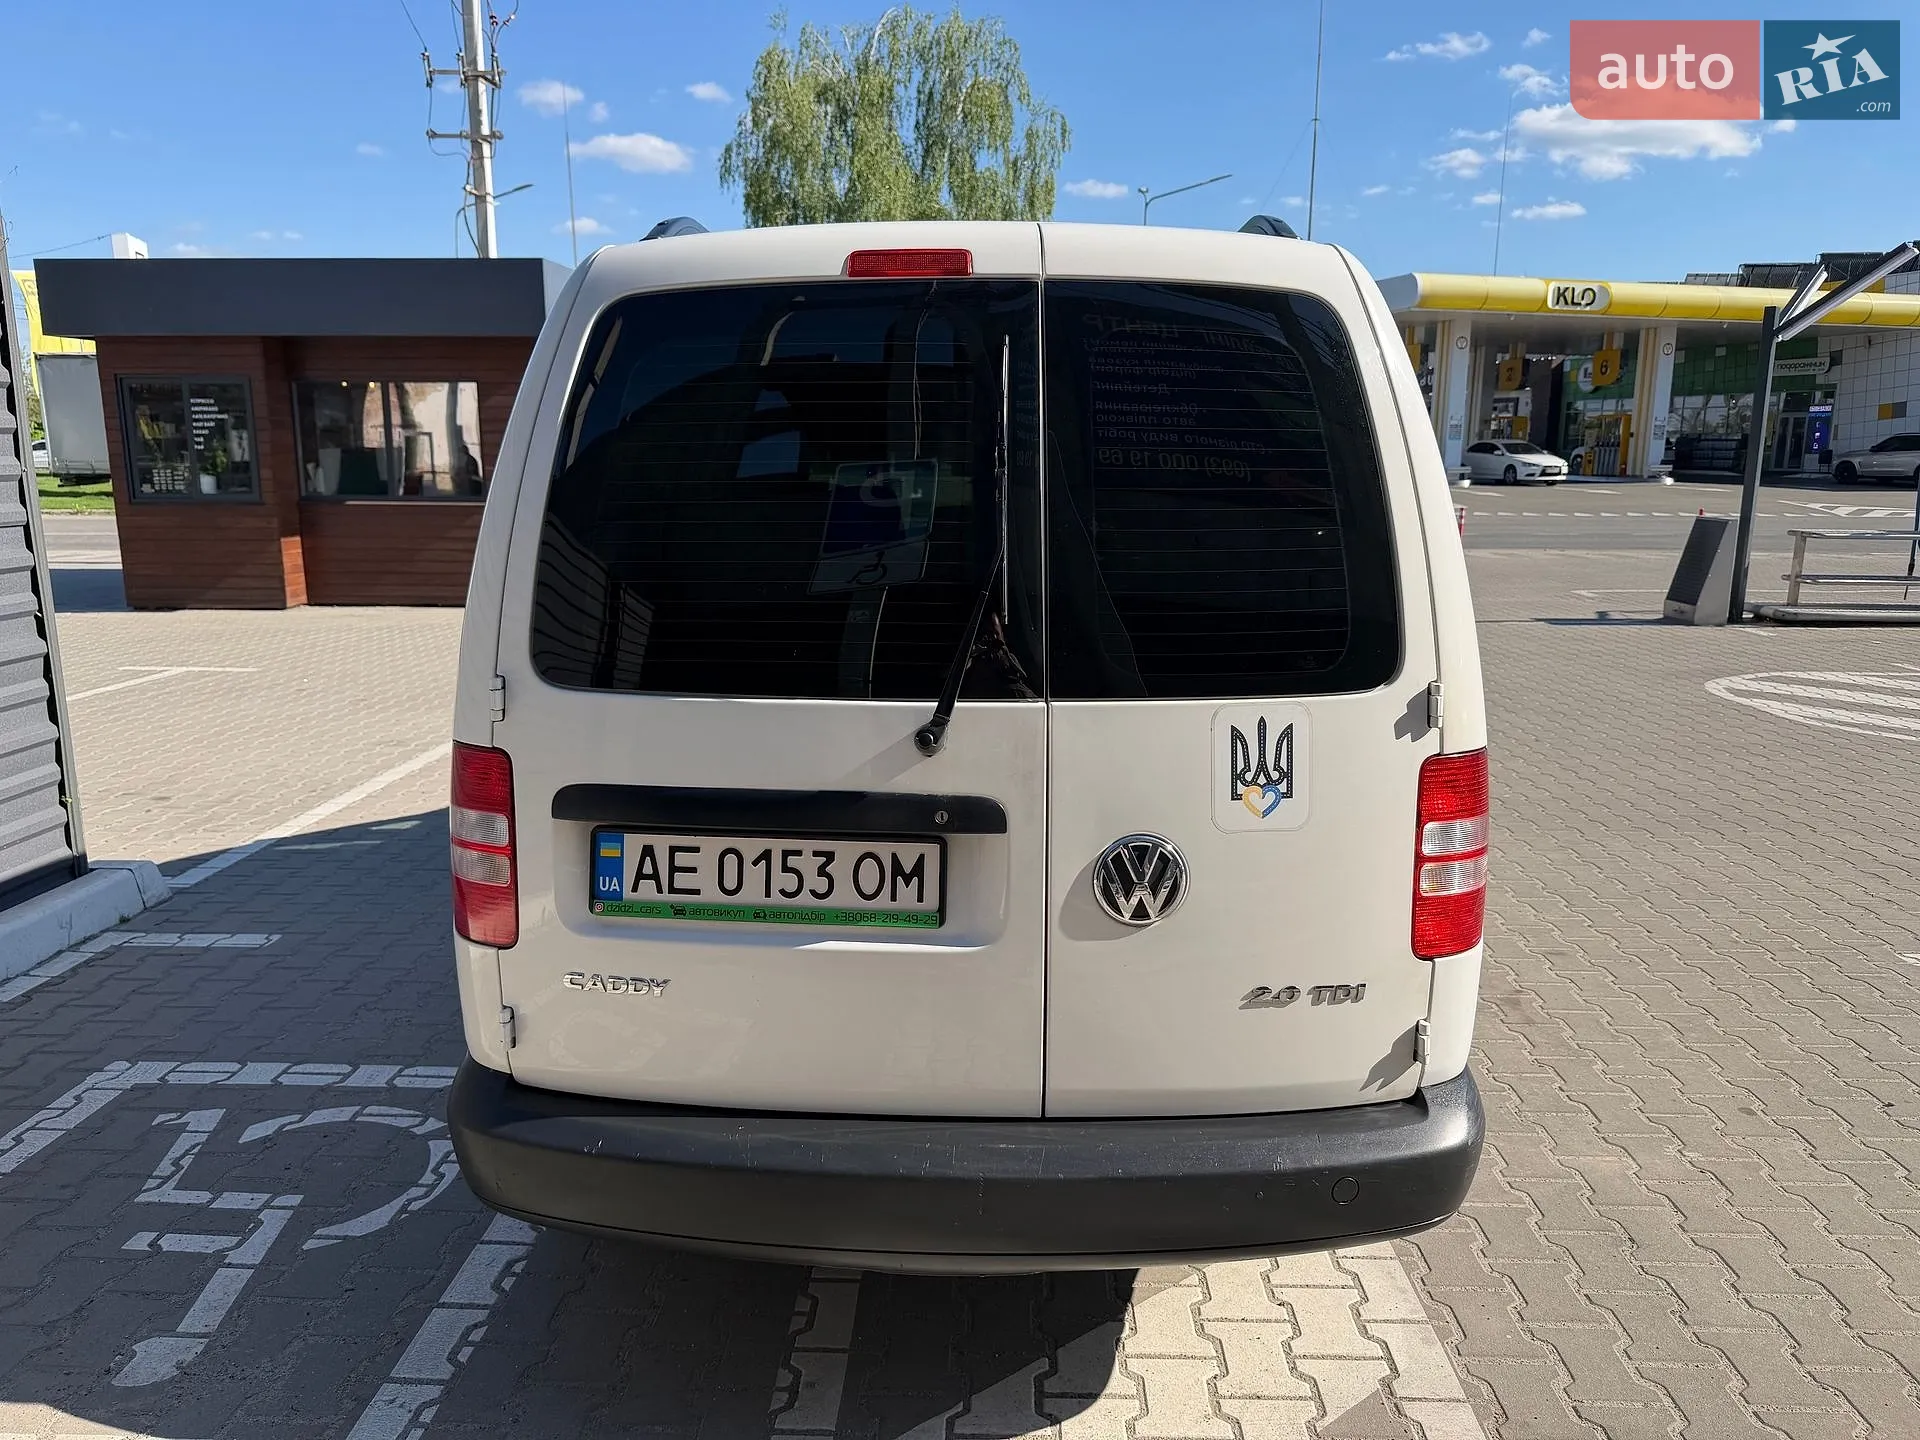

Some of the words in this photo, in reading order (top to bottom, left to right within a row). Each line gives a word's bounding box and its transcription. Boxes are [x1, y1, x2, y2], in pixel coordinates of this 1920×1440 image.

[1555, 286, 1597, 306] KLO
[1600, 360, 1609, 376] 6
[600, 876, 620, 892] UA
[631, 845, 702, 895] AE
[717, 847, 836, 901] 0153
[852, 851, 926, 904] OM
[606, 903, 662, 914] dzidzi_cars
[688, 907, 745, 918] автовикуп
[769, 911, 826, 921] автопідбір
[834, 912, 938, 925] +38068-219-49-29
[563, 972, 672, 997] CADDY
[1246, 986, 1301, 1006] 2.0
[1310, 983, 1367, 1004] TDI
